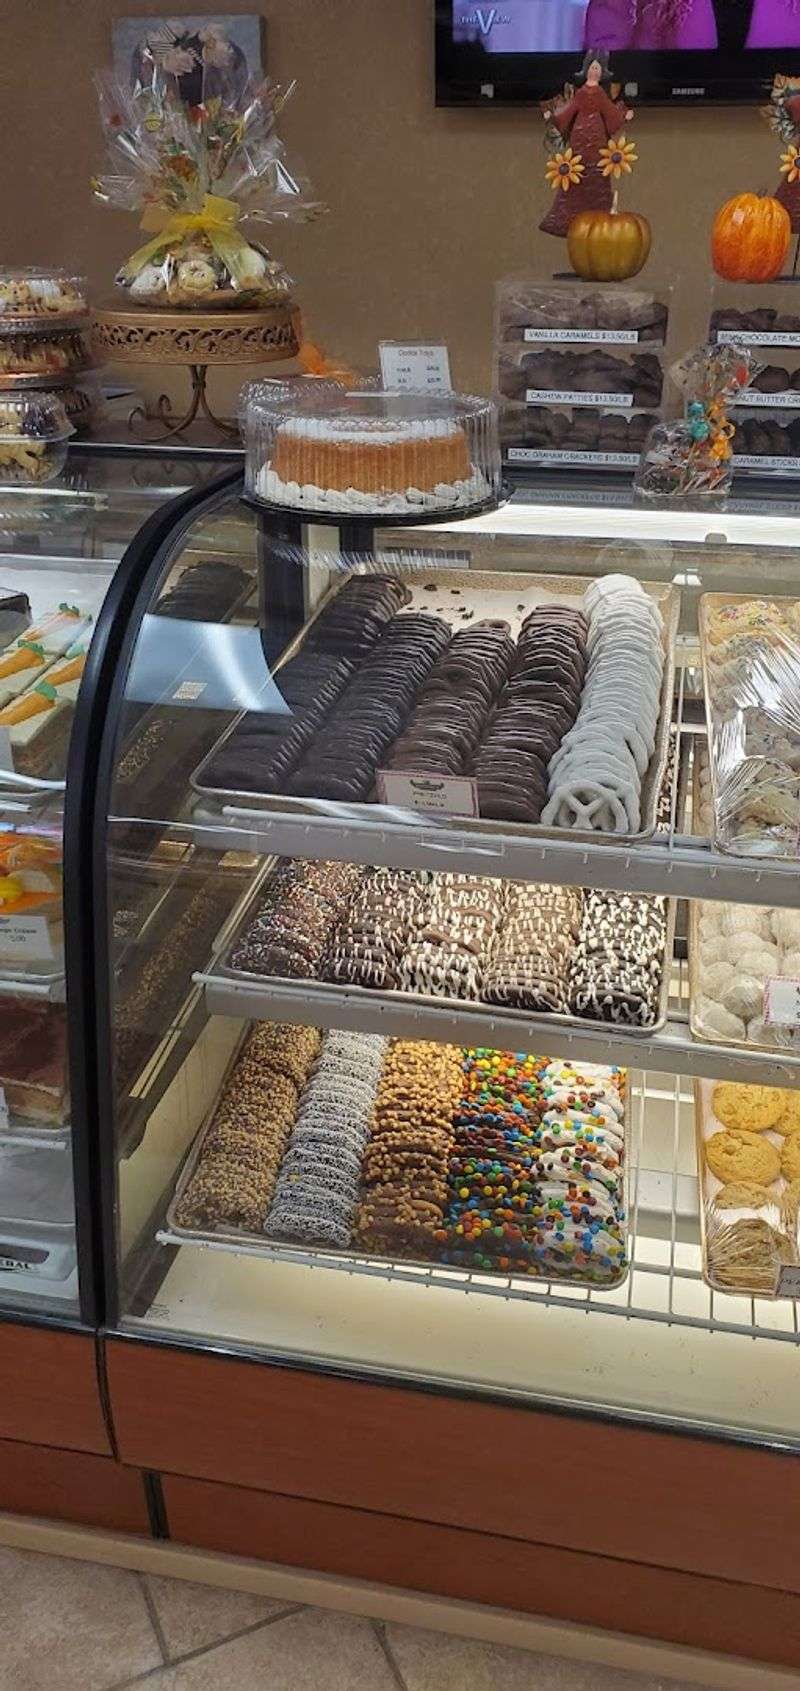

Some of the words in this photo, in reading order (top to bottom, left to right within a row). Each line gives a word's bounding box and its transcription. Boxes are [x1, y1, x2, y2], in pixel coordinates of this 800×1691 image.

[671, 87, 705, 96] SAMSUNG
[560, 331, 600, 340] CARAMELS
[530, 392, 562, 400] CASHEW
[753, 395, 786, 404] BUTTER
[533, 451, 563, 460] GRAHAM
[563, 452, 604, 461] CRACKERS
[734, 456, 769, 465] CARAMEL
